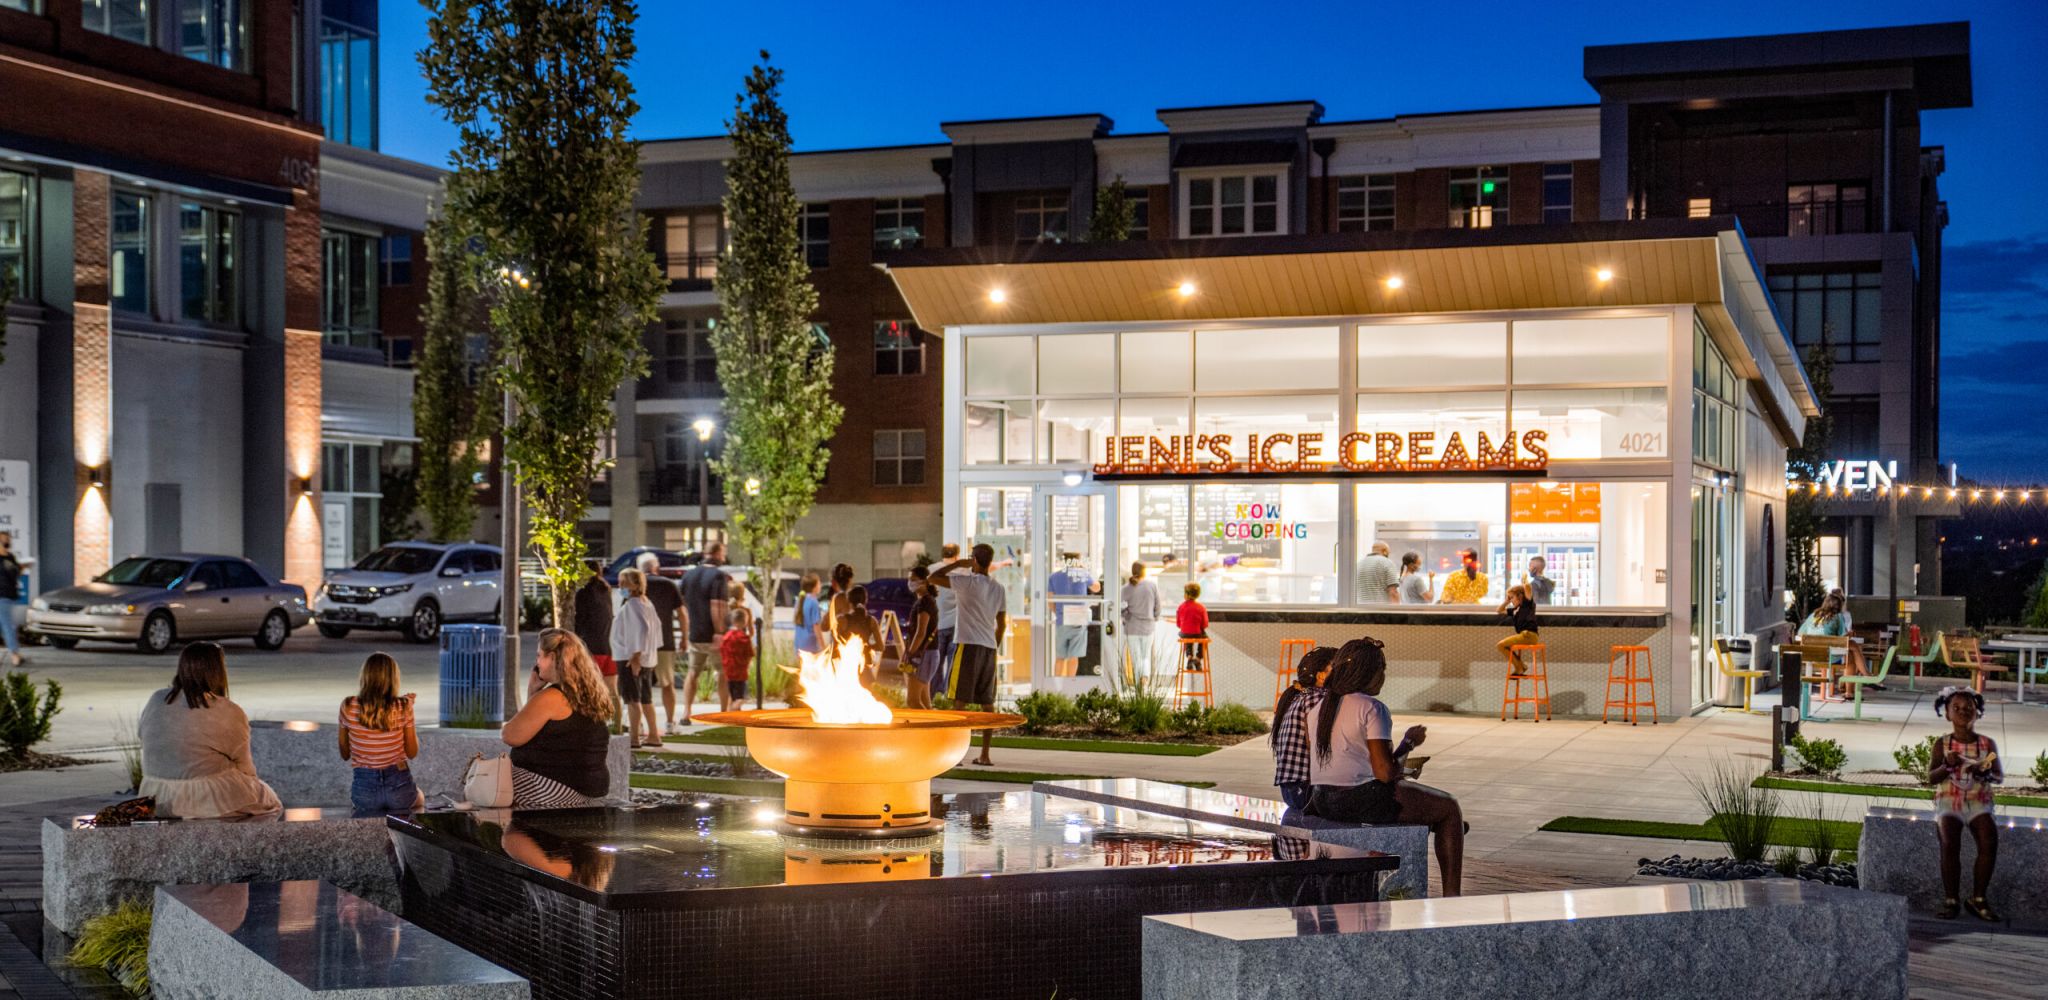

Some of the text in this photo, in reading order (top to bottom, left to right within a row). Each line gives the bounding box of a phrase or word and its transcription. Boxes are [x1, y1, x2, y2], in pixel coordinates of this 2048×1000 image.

[1093, 430, 1549, 473] JENI'S ICE CREAMS
[1620, 432, 1662, 453] 4021
[1236, 503, 1281, 519] NOW
[1212, 522, 1307, 540] SCOOPING
